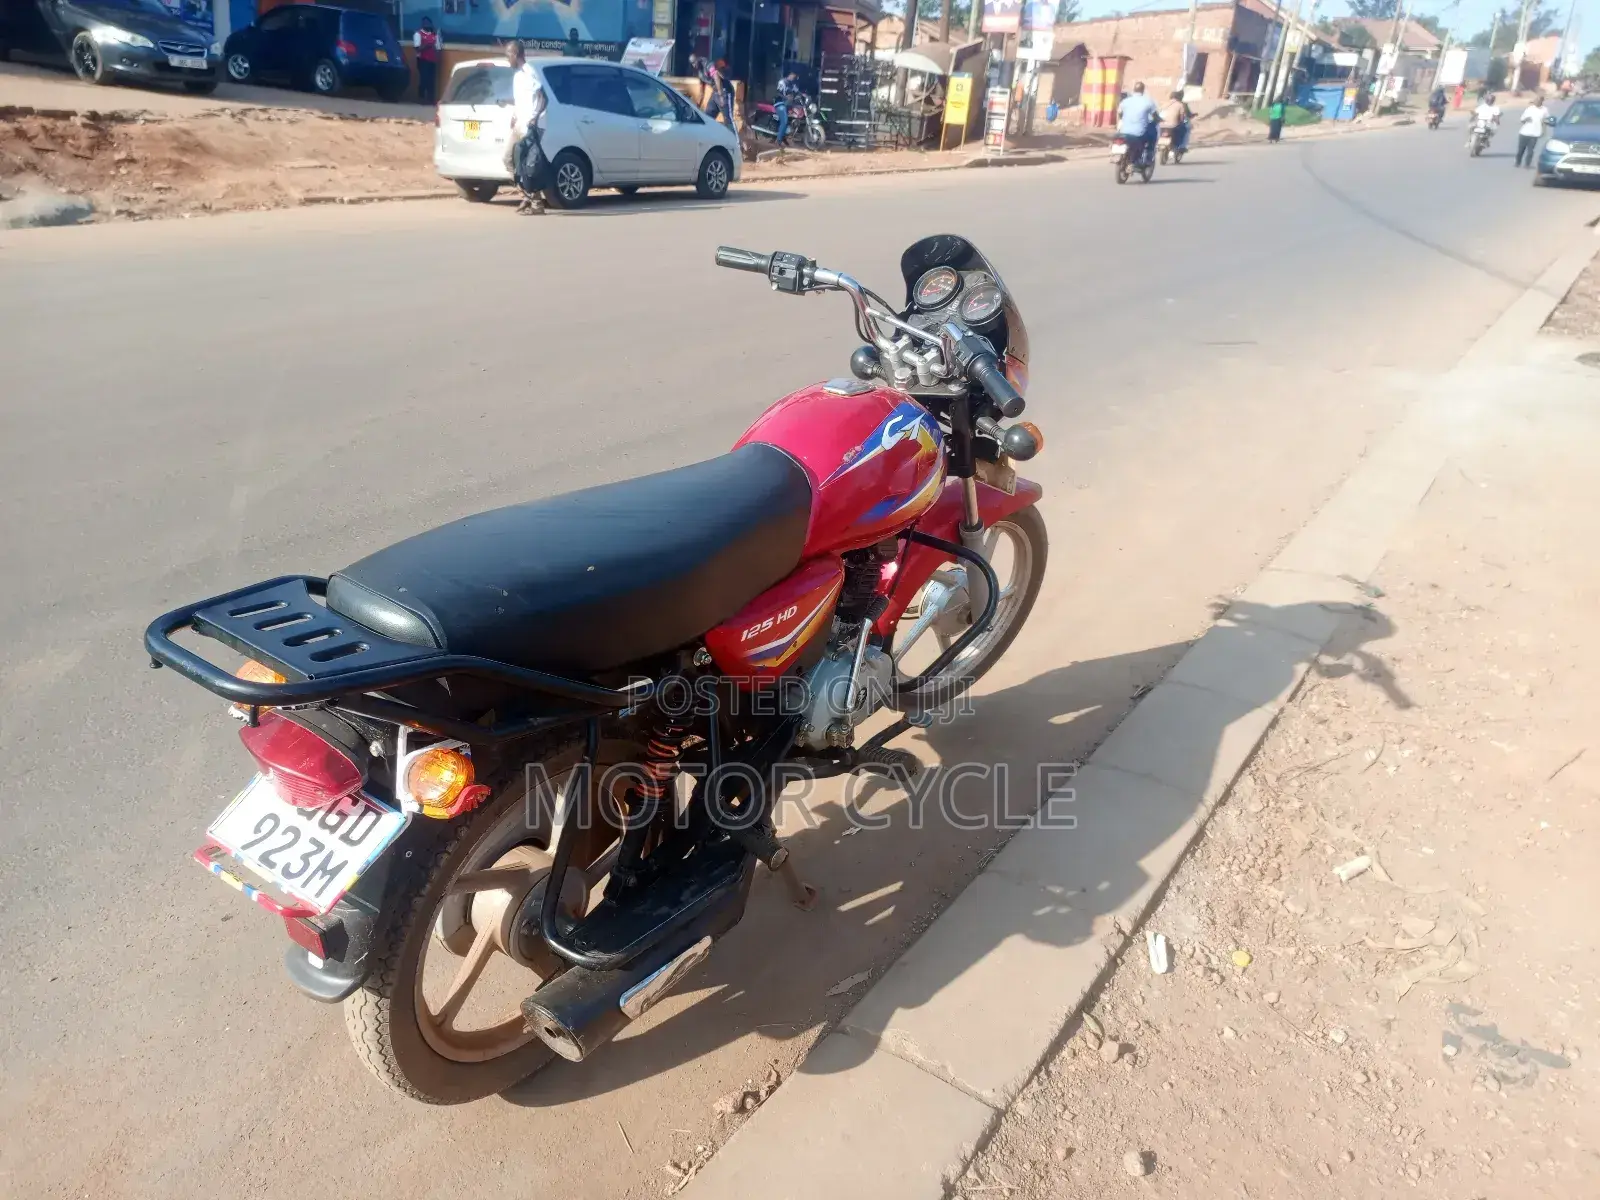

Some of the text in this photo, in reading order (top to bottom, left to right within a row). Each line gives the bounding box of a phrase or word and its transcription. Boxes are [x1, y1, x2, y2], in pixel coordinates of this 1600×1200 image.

[740, 605, 798, 642] 125 HD
[241, 812, 349, 899] 923M
